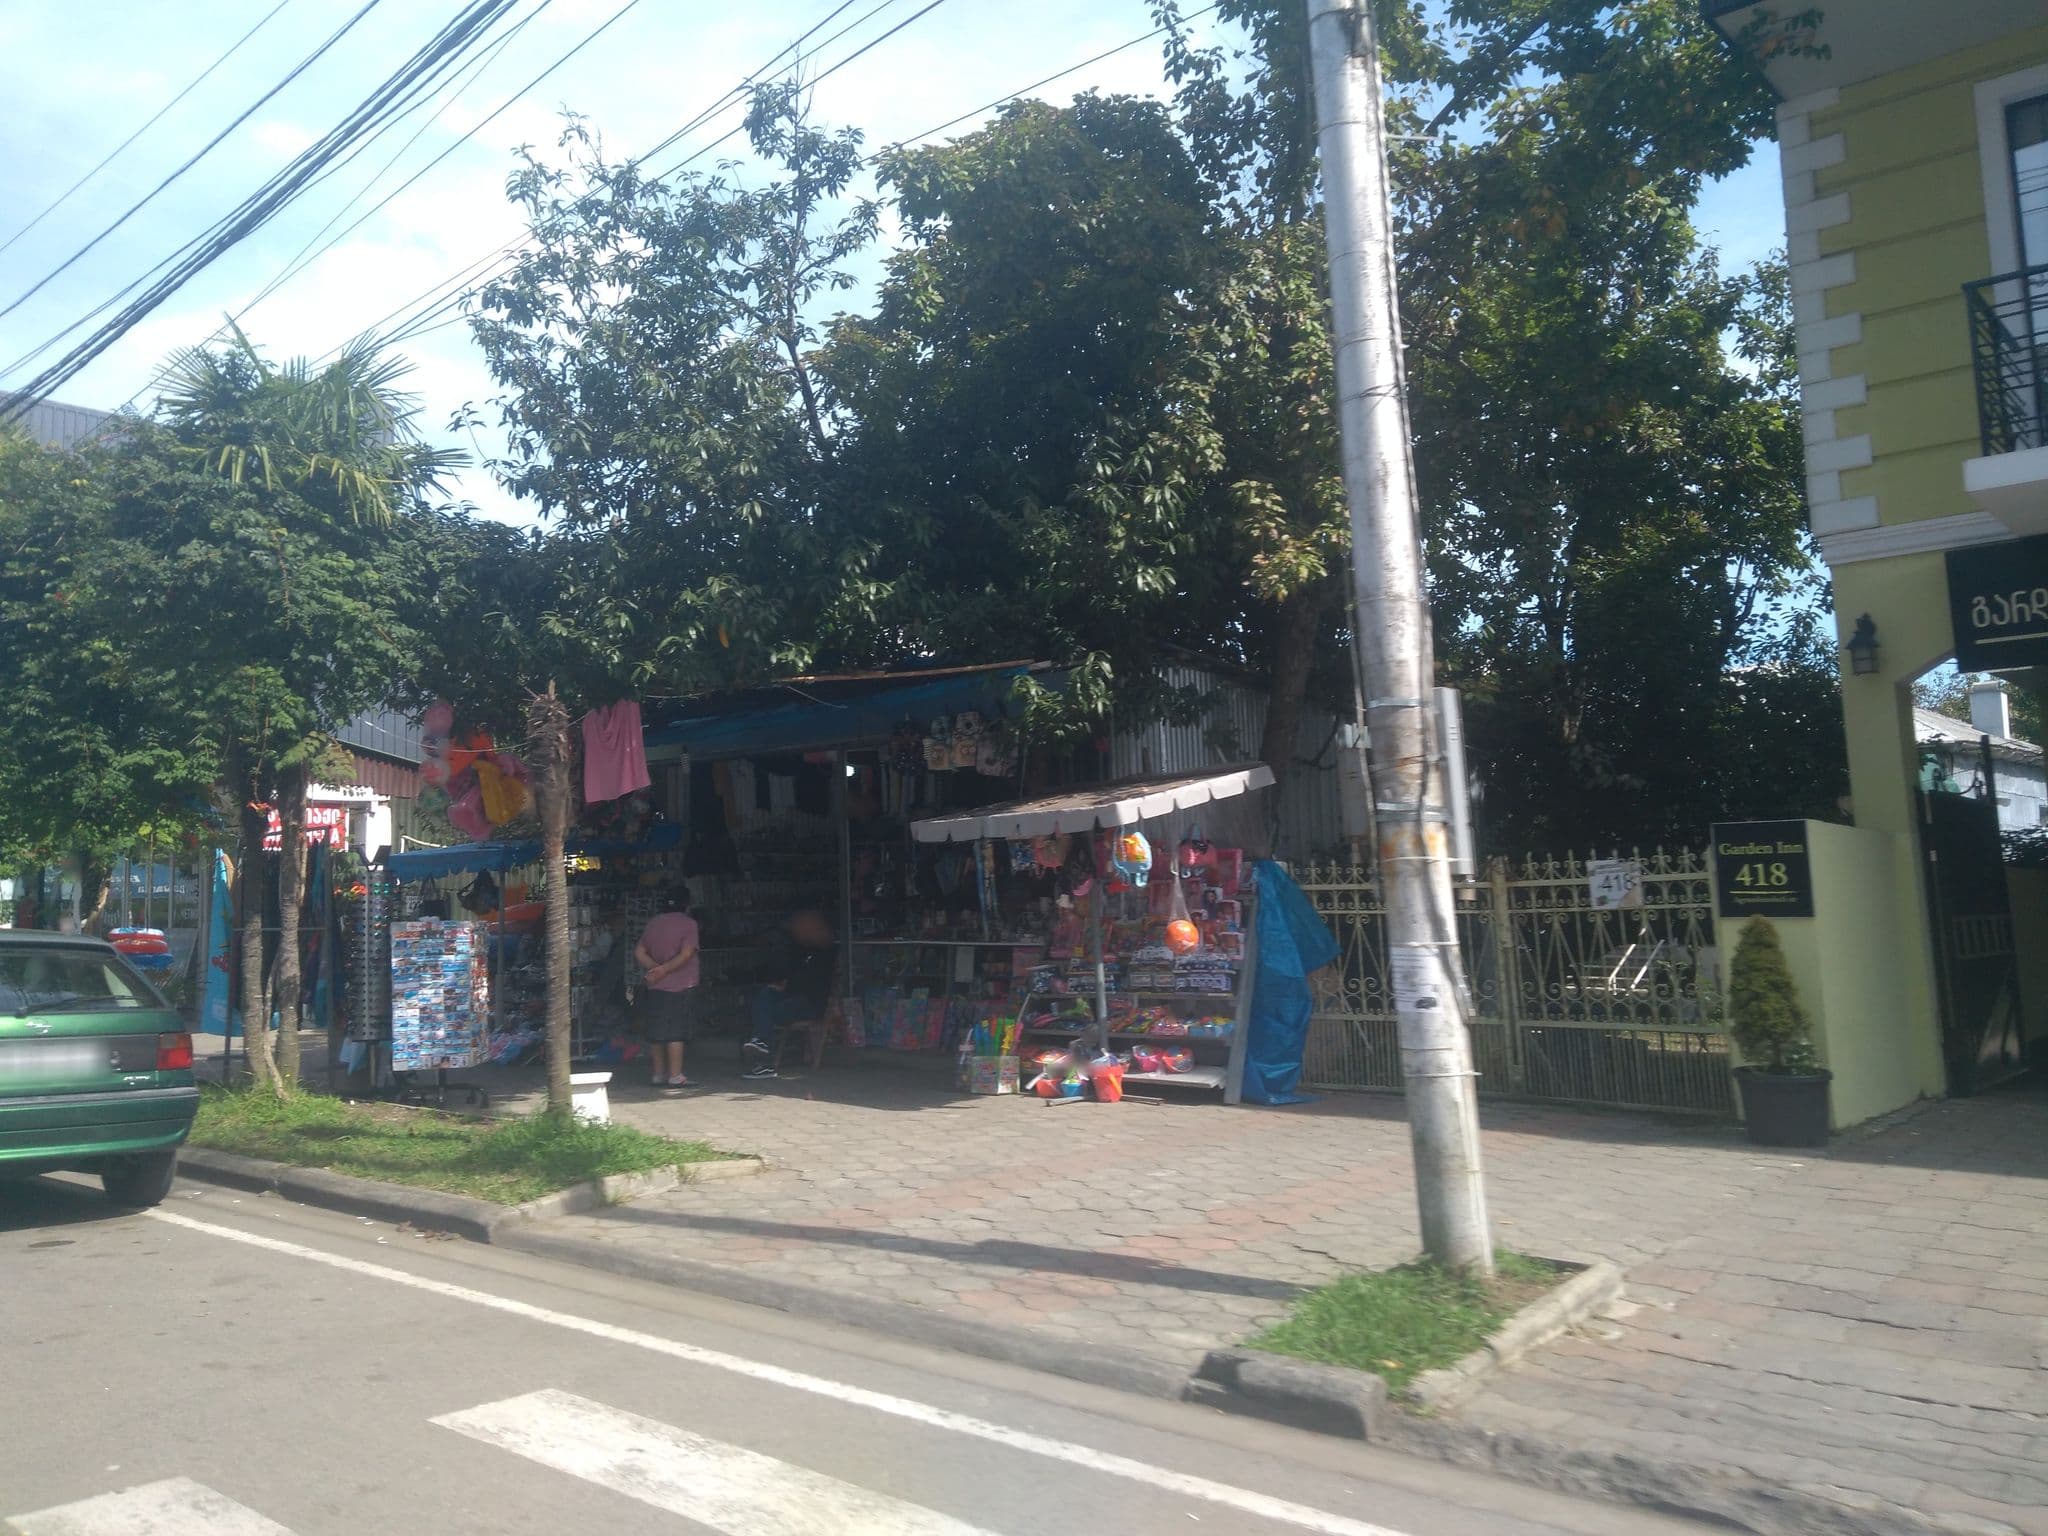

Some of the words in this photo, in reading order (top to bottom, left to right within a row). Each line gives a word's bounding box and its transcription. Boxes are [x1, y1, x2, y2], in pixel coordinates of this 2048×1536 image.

[1719, 842, 1773, 855] Garden
[1776, 841, 1803, 854] Inn
[1735, 862, 1789, 887] 418
